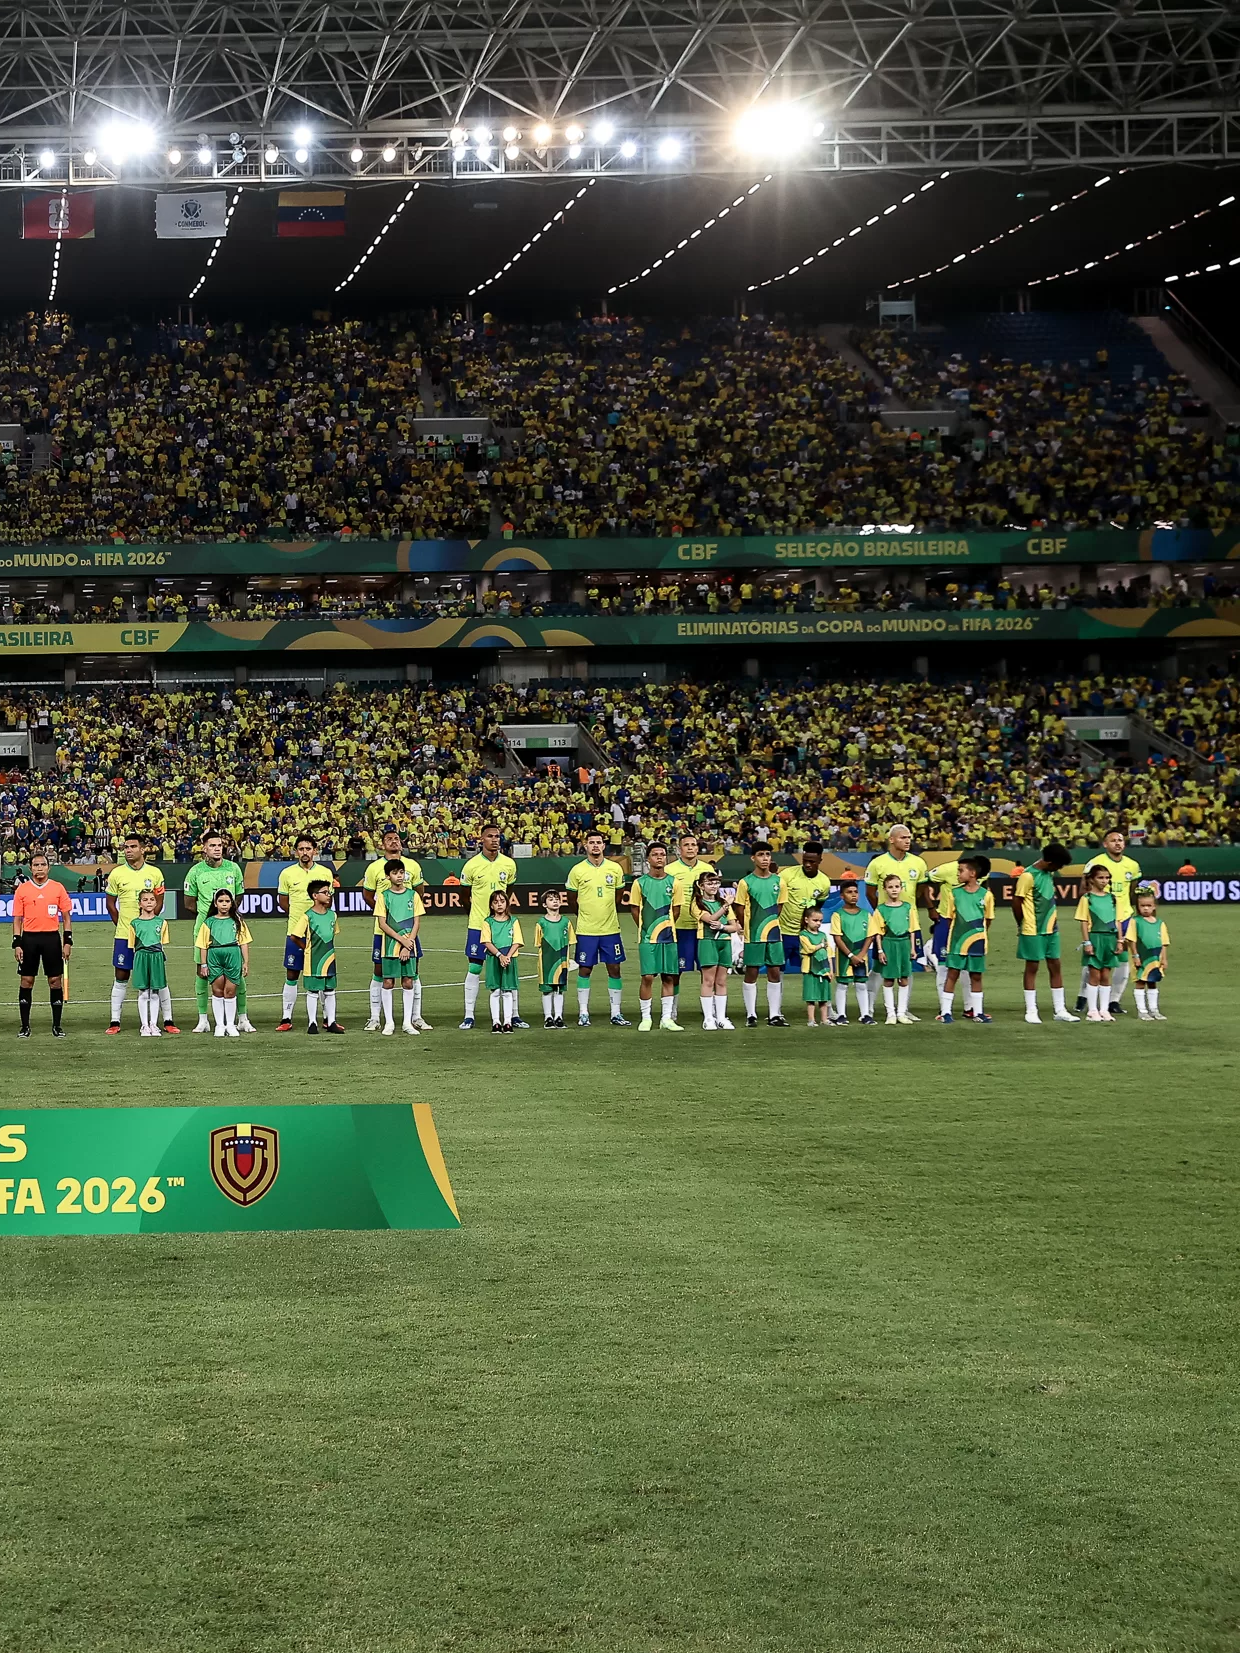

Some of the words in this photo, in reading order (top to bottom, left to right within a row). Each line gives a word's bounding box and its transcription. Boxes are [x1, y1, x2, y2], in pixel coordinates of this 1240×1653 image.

[677, 543, 718, 560] CBF
[775, 540, 860, 560] SELEÇÃO
[863, 540, 970, 557] BRASILEIRA
[1026, 538, 1067, 555] CBF
[13, 553, 79, 567] MUNDO
[80, 558, 92, 566] DA
[94, 552, 124, 566] FIFA
[677, 619, 798, 636] ELIMINATÓRIAS
[801, 626, 814, 634] DA
[815, 620, 864, 634] COPA
[867, 625, 881, 633] DO
[881, 619, 946, 633] MUNDO
[962, 618, 992, 631] FIFA
[120, 629, 160, 646] CBF
[597, 886, 603, 898] 8
[1163, 880, 1224, 901] GRUPO
[339, 892, 373, 912] LIM
[614, 943, 621, 954] 8
